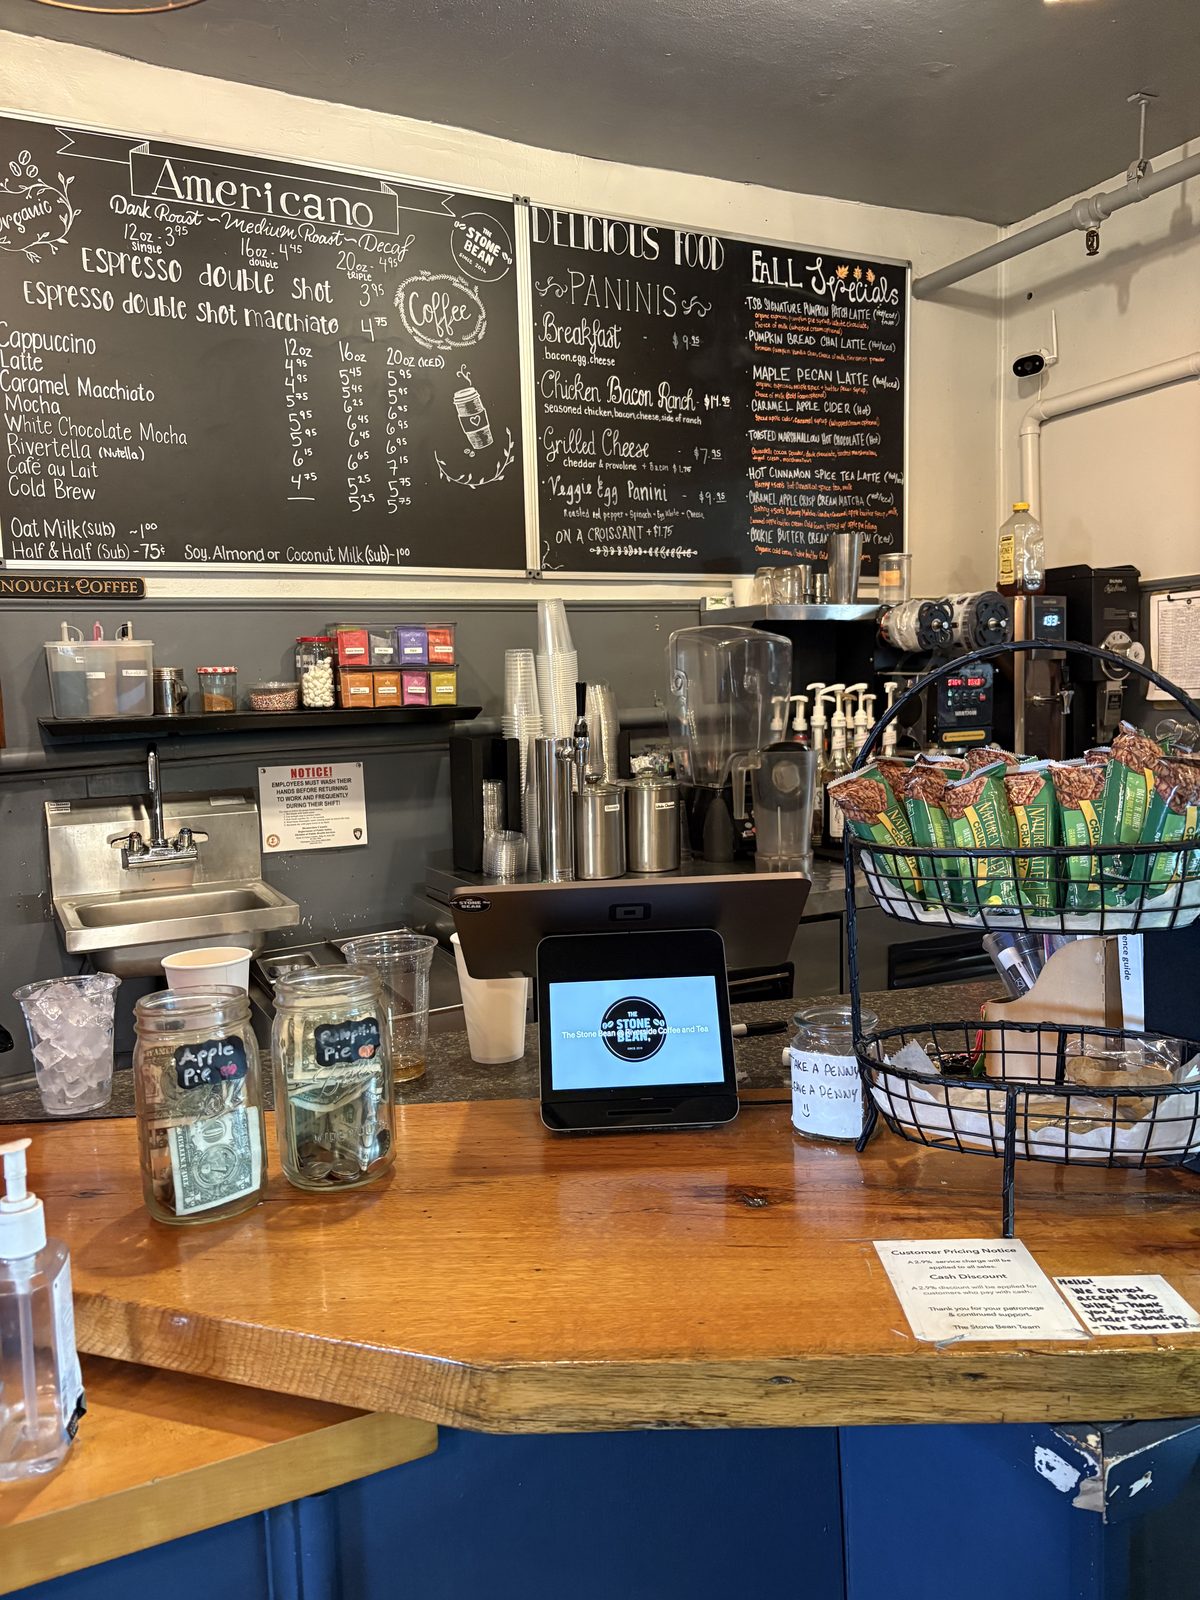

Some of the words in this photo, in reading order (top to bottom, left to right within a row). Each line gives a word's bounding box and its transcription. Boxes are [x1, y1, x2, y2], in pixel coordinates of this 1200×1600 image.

[152, 158, 374, 228] Americano
[110, 195, 151, 219] Dark
[155, 204, 204, 227] Roast
[221, 211, 297, 240] Medium
[298, 222, 345, 246] Roast
[358, 233, 415, 261] Decaf
[531, 206, 660, 260] DELICIOUS
[674, 230, 725, 271] FOOD
[465, 226, 501, 257] STONE
[249, 257, 279, 270] double
[463, 239, 495, 267] BEAN
[81, 247, 183, 284] Espresso
[199, 263, 275, 295] double
[806, 257, 899, 305] Specials
[567, 268, 677, 318] PANINIS
[23, 280, 114, 310] Espresso
[122, 291, 188, 321] double
[244, 306, 339, 335] macchiato
[409, 291, 472, 338] Coffee
[849, 307, 871, 320] LATTE
[0, 320, 96, 355] Cappuccino
[538, 311, 622, 354] Breakfast
[748, 330, 783, 345] PUMPKIN
[787, 333, 816, 346] BREAD
[821, 336, 838, 348] CHAI
[841, 338, 867, 351] LATTE
[0, 350, 43, 372] Latte
[0, 369, 70, 396] Caramel
[77, 376, 155, 402] Macchiato
[753, 365, 790, 381] MAPLE
[797, 368, 833, 382] PECAN
[837, 370, 870, 387] LATTE
[541, 369, 601, 402] Chicken
[607, 375, 654, 407] Bacon
[658, 381, 696, 413] Ranch
[5, 393, 61, 415] Mocha
[751, 400, 794, 413] CARAMEL
[796, 400, 820, 412] APPLE
[824, 402, 851, 414] CIDER
[4, 412, 52, 435] White
[58, 416, 132, 441] Chocolate
[139, 422, 187, 445] Mocha
[7, 432, 92, 460] Rivertella
[98, 445, 145, 461] (Nutella)
[543, 425, 597, 462] Grilled
[602, 428, 650, 458] Cheese
[7, 454, 41, 476] Café
[48, 463, 66, 478] au
[71, 460, 99, 478] Lait
[563, 458, 597, 469] cheddar
[749, 467, 767, 480] HOT
[769, 467, 811, 480] CINNAMON
[814, 469, 836, 480] SPICE
[840, 470, 855, 481] TEA
[857, 470, 881, 483] LATTE
[8, 475, 46, 497] Cold
[54, 478, 96, 500] Brew
[548, 475, 593, 506] Veggie
[597, 475, 618, 508] Egg
[627, 480, 668, 502] Panini
[779, 494, 798, 506] APPLE
[10, 517, 40, 538] Oat
[556, 528, 572, 544] ON
[577, 529, 584, 544] A
[588, 525, 644, 542] CROISSANT
[777, 528, 805, 544] BUTTER
[12, 541, 45, 560] Half
[48, 541, 59, 559] &
[62, 542, 92, 561] Half
[213, 545, 265, 562] Almond
[267, 549, 281, 562] or
[286, 546, 336, 564] Coconut
[338, 546, 363, 564] Milk
[75, 578, 138, 595] COFFEE
[290, 766, 332, 779] NOTICE!
[271, 780, 304, 788] EMPLOYEES
[976, 802, 999, 841] NATURE
[1027, 807, 1044, 847] NATURE
[1122, 957, 1131, 981] guide
[562, 1031, 575, 1039] The
[577, 1030, 597, 1038] Stone
[696, 1025, 709, 1033] Tea
[616, 1018, 651, 1029] STONE
[179, 1042, 234, 1067] Apple
[324, 1047, 352, 1061] Pie
[184, 1068, 211, 1086] Pie
[812, 1063, 819, 1074] A
[825, 1063, 859, 1079] PENNY
[819, 1085, 858, 1102] PENNY
[891, 1248, 942, 1256] Customer
[943, 1247, 980, 1256] Pricing
[981, 1246, 1017, 1254] Notice
[929, 1272, 955, 1280] Cash
[958, 1272, 1008, 1280] Discount
[1058, 1278, 1096, 1287] Hello!
[1071, 1287, 1093, 1295] We
[1097, 1286, 1144, 1294] cannot
[1077, 1294, 1119, 1303] accept
[1085, 1309, 1107, 1318] you
[1134, 1308, 1165, 1317] your
